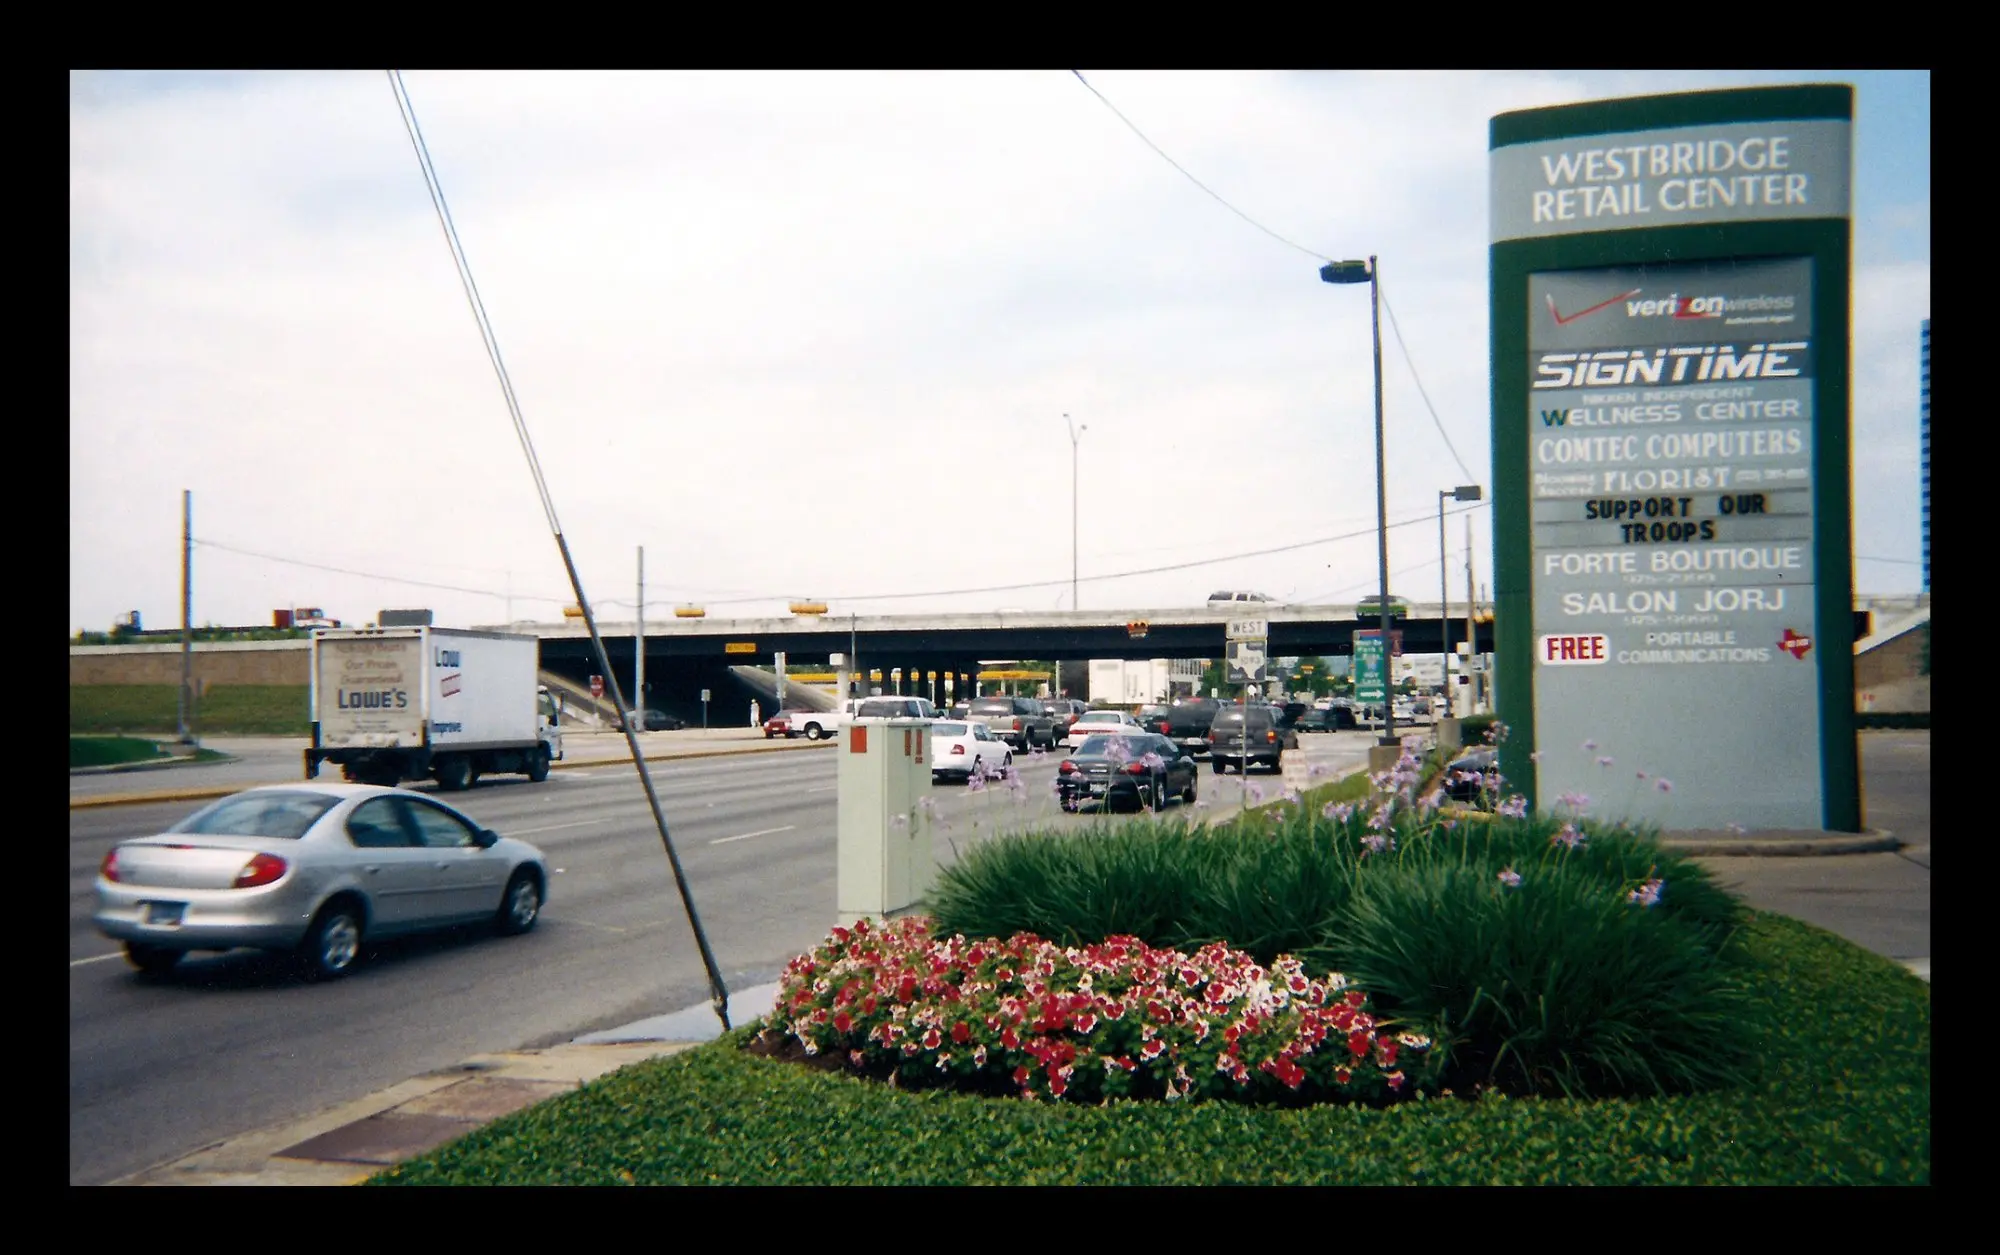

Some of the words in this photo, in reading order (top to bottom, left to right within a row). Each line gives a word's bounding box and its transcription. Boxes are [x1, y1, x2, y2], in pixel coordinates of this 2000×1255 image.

[1540, 136, 1790, 187] WESTBRIDGE
[1532, 184, 1650, 223] RETAIL
[1658, 173, 1808, 212] CENTER
[1626, 293, 1724, 319] verizon
[1643, 386, 1755, 402] INDEPENDENT
[1541, 404, 1682, 427] WELLNESS
[1695, 400, 1800, 421] CENTER
[1538, 434, 1639, 464] COMTEC
[1645, 428, 1803, 460] COMPUTERS
[1603, 467, 1730, 492] FLORIST
[1585, 496, 1693, 521] SUPPORT
[1717, 494, 1768, 515] OUR
[1621, 520, 1715, 544] TROOPS
[1544, 551, 1637, 576] FORTE
[1650, 547, 1802, 573] BOUTIQUE
[1563, 590, 1677, 616] SALON
[1693, 588, 1786, 613] JORJ
[1232, 620, 1263, 634] WEST
[1646, 630, 1737, 648] PORTABLE
[1546, 636, 1606, 661] FREE
[1616, 647, 1772, 665] COMMUNICATIONS
